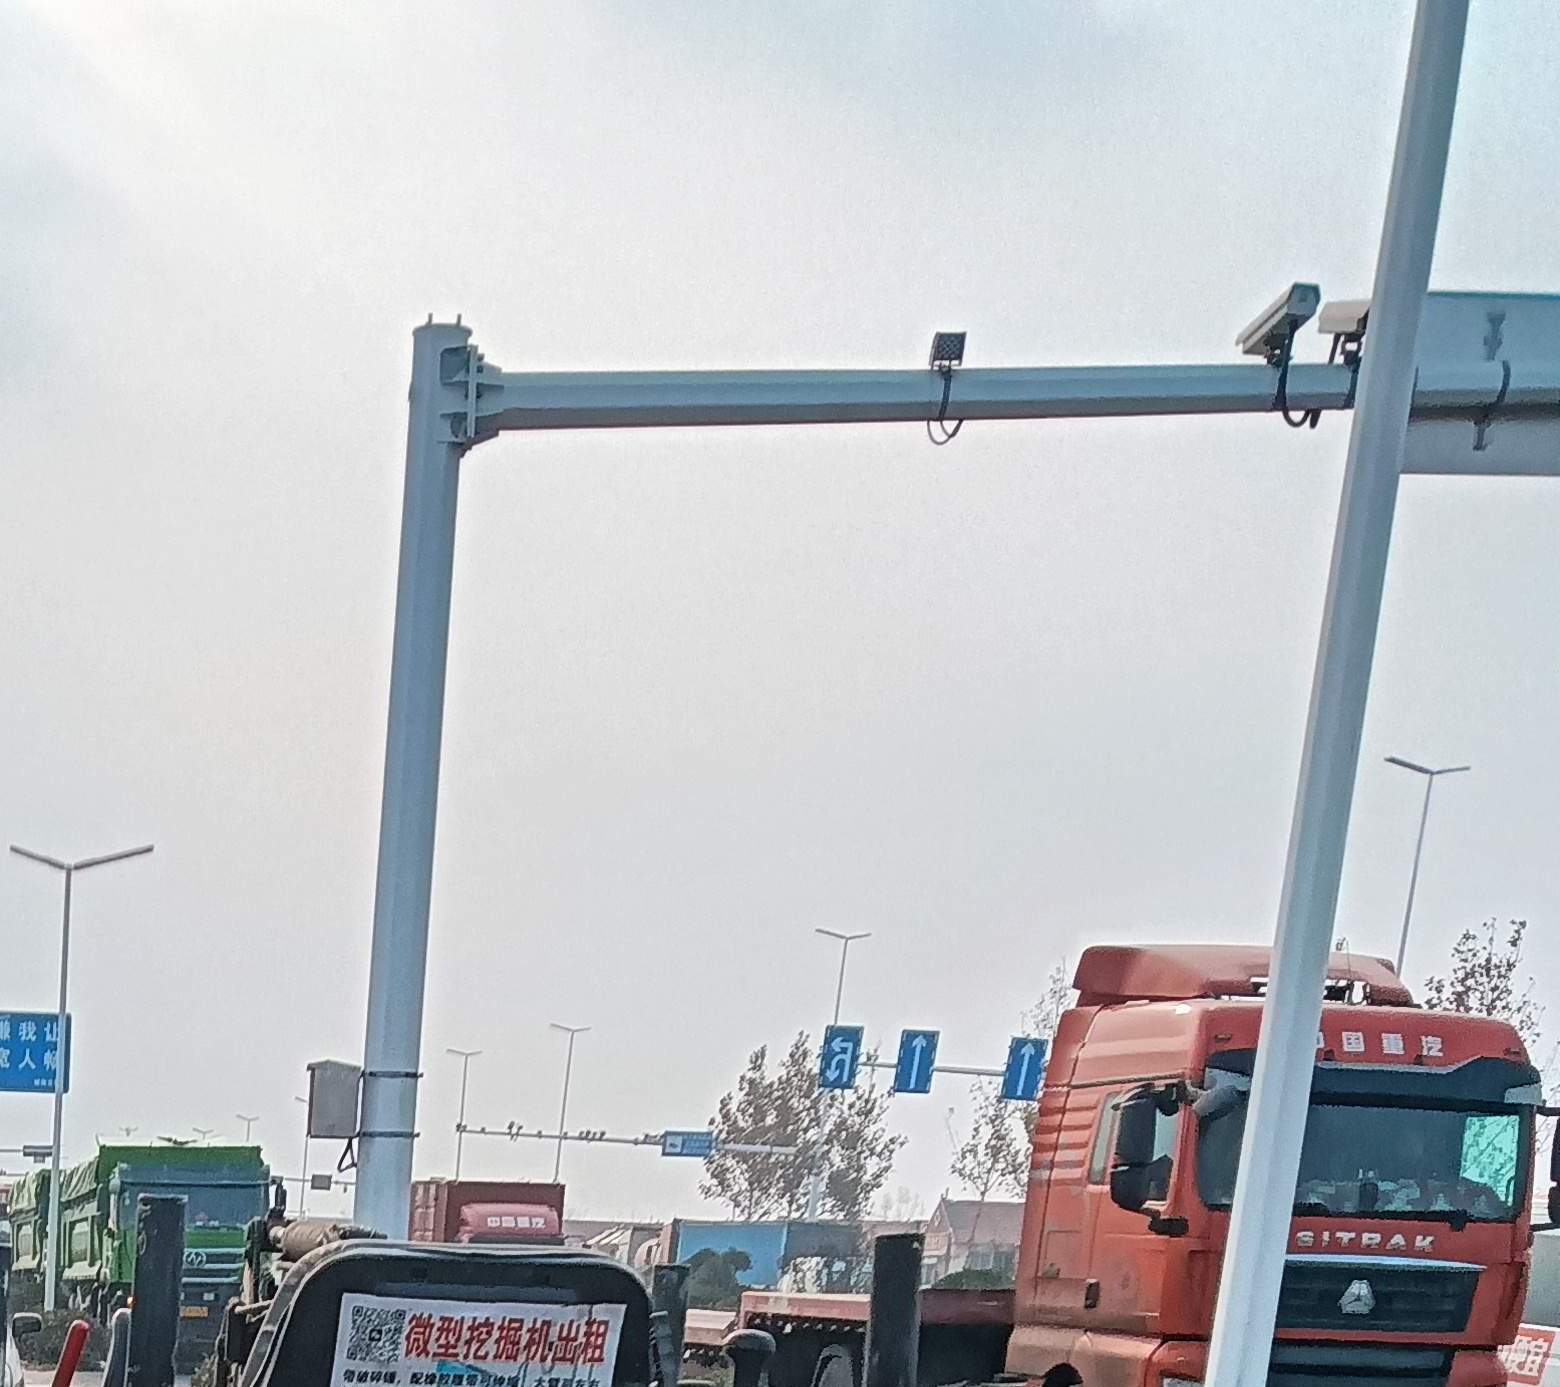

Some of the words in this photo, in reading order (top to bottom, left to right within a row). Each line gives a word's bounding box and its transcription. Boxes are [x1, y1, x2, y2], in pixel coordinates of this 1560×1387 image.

[1317, 1031, 1443, 1057] 国重汽
[1295, 1231, 1434, 1252] SITRAK
[404, 1312, 610, 1364] 微型挖掘机出租
